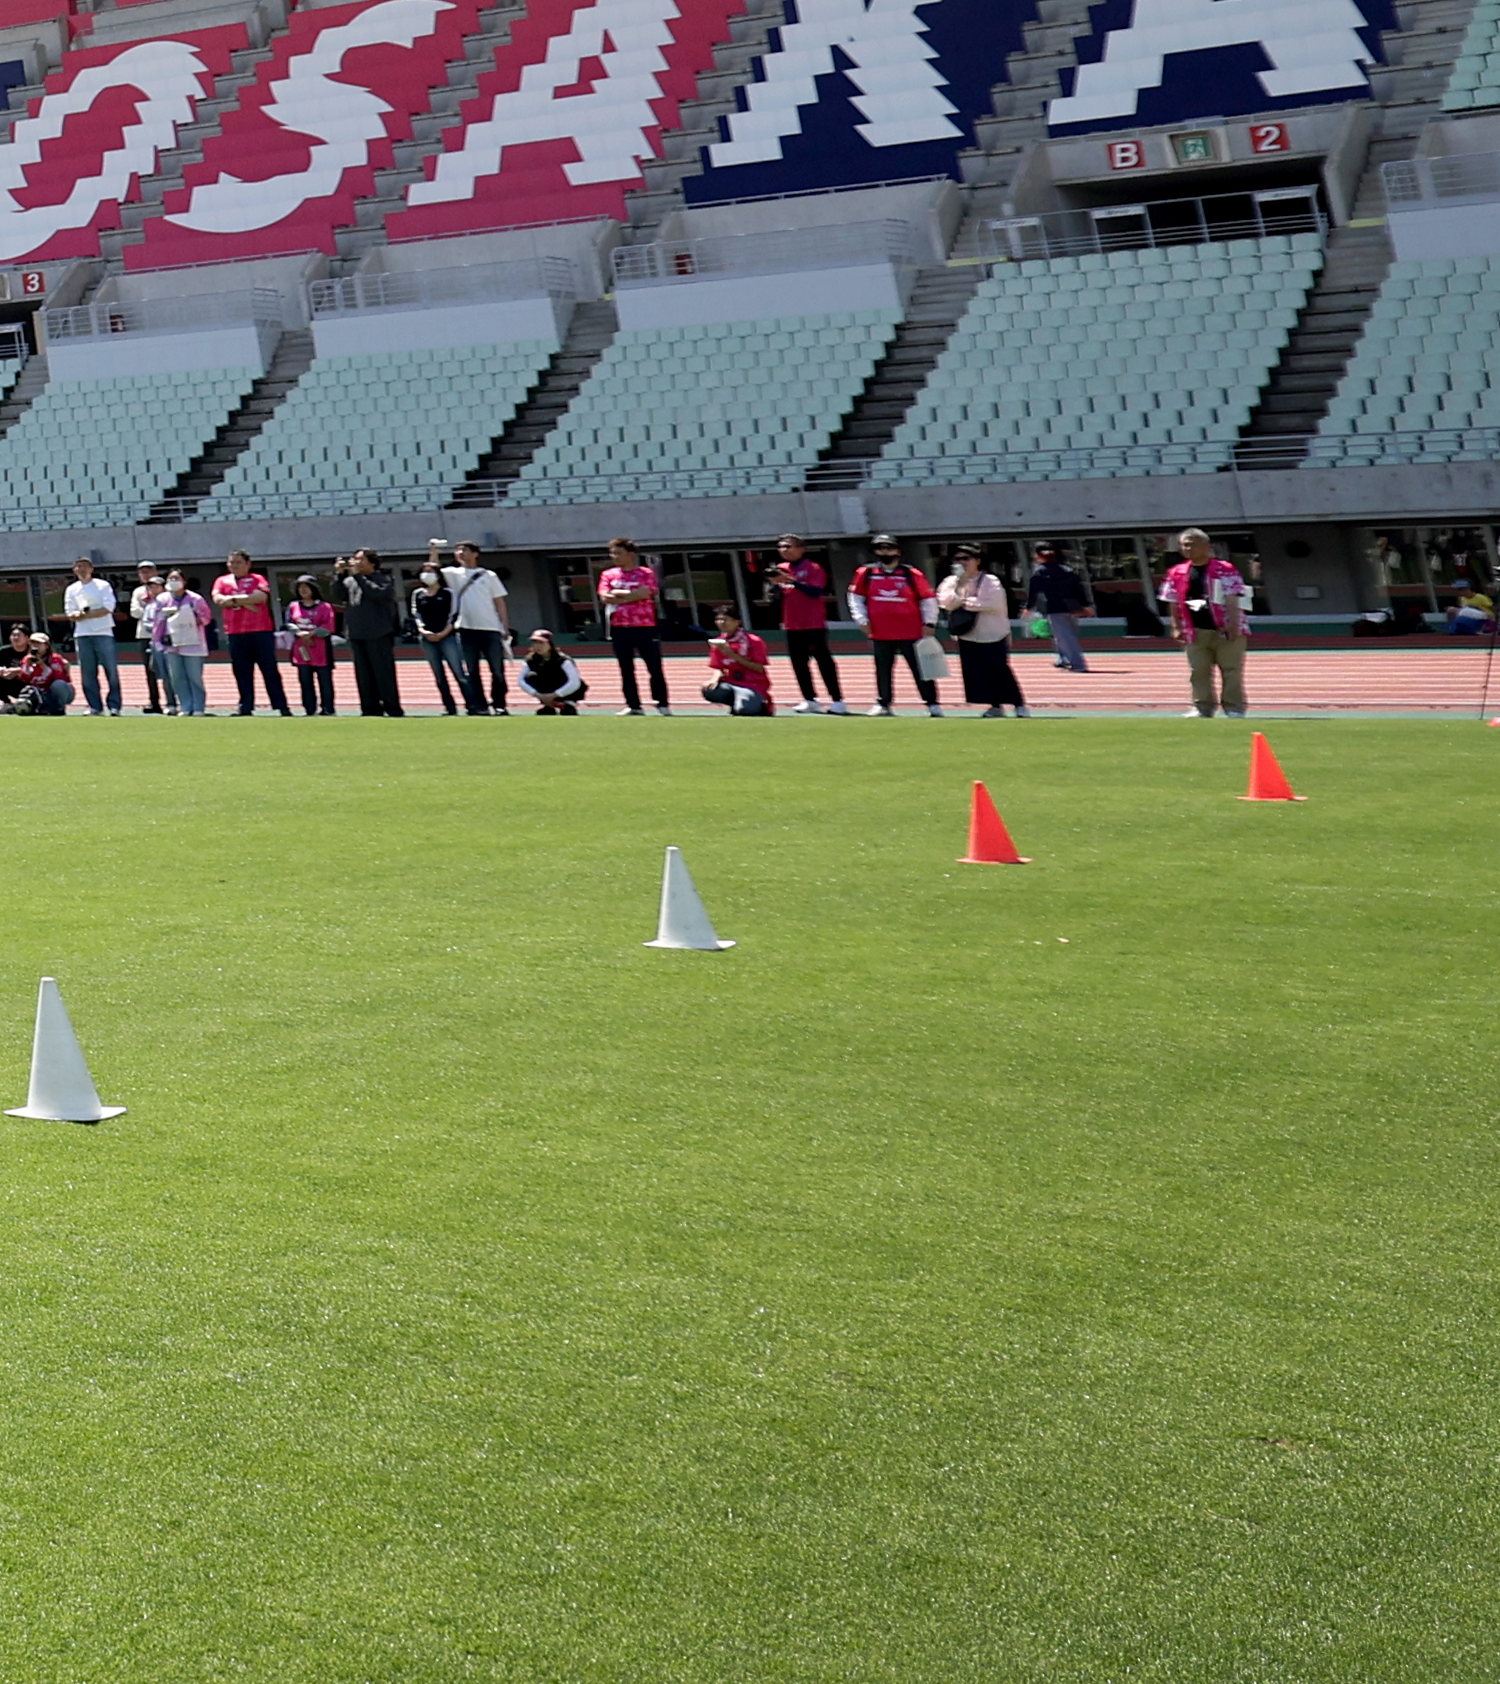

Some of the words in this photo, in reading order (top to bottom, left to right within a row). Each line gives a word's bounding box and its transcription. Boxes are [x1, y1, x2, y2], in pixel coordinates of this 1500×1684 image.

[1116, 144, 1139, 168] B
[1257, 127, 1280, 151] 2
[27, 274, 39, 292] 3
